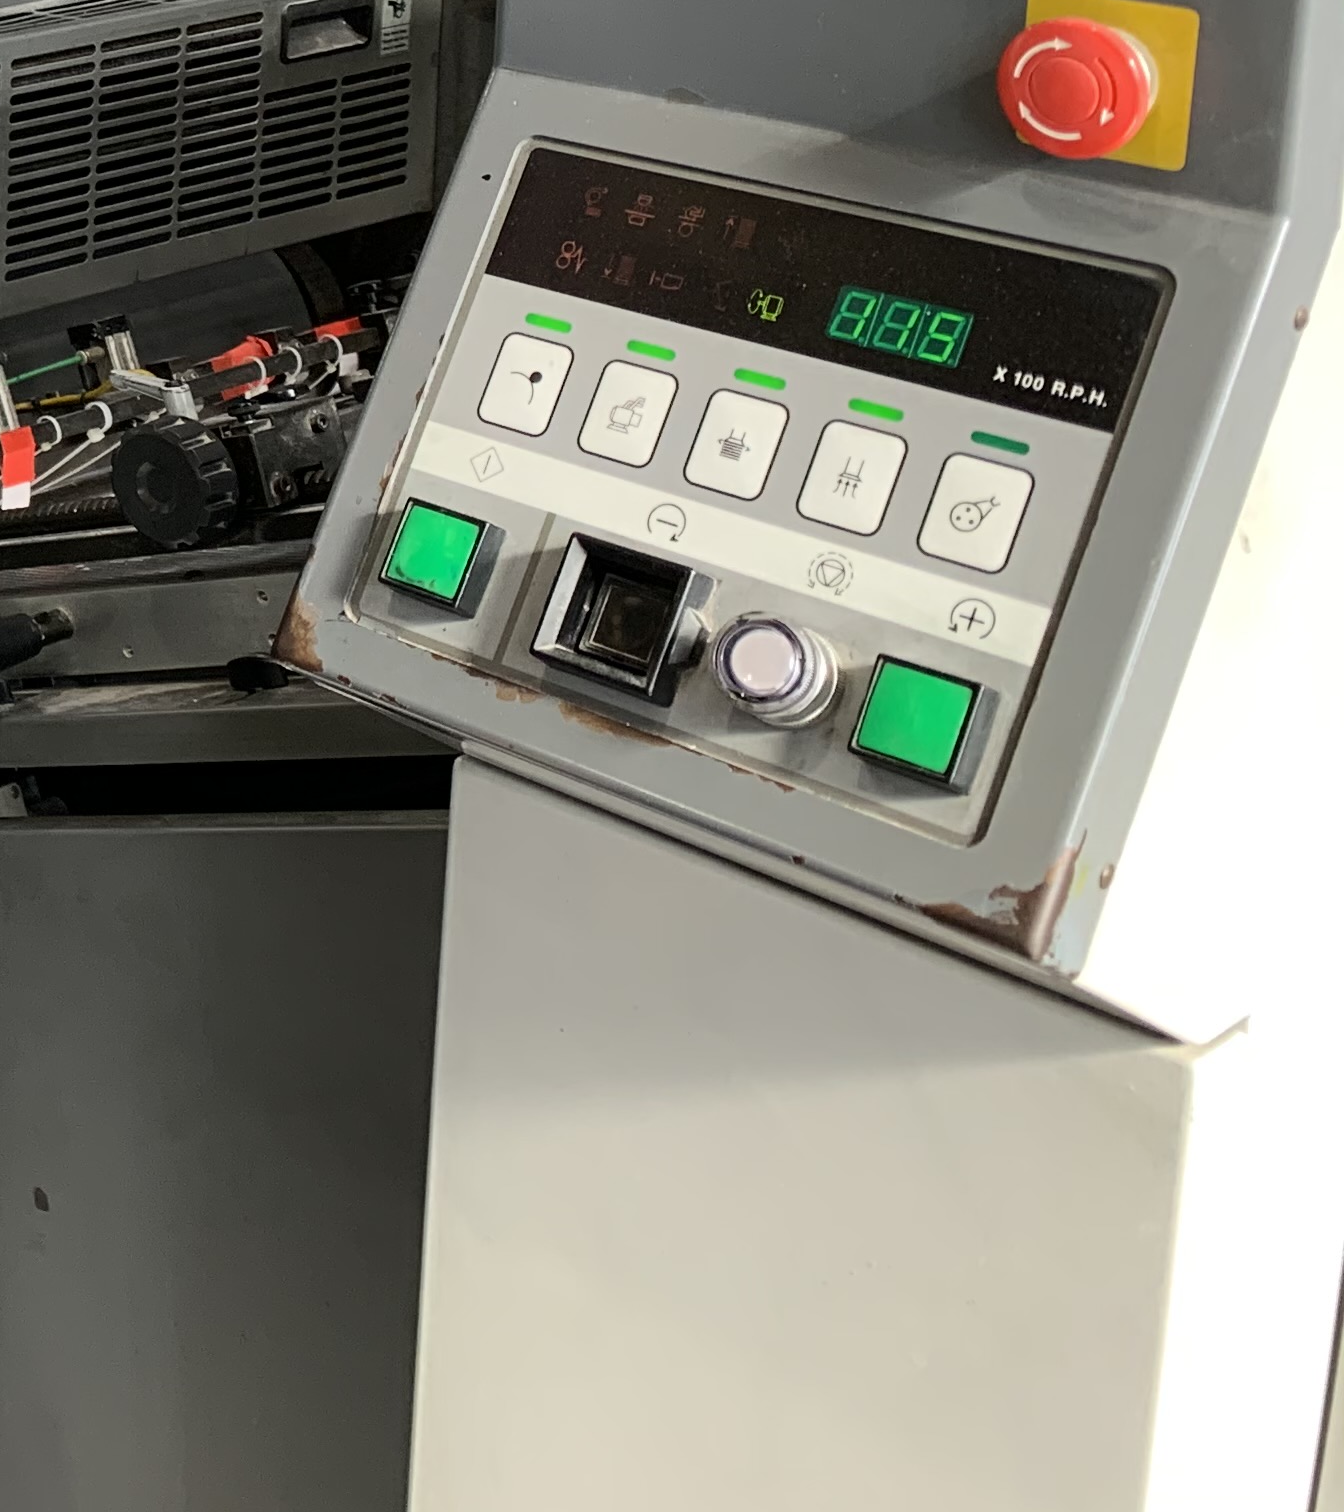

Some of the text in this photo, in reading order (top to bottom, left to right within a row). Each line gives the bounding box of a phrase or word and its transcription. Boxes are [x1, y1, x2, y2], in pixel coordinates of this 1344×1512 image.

[993, 364, 1109, 408] X 100 R.P.H.
